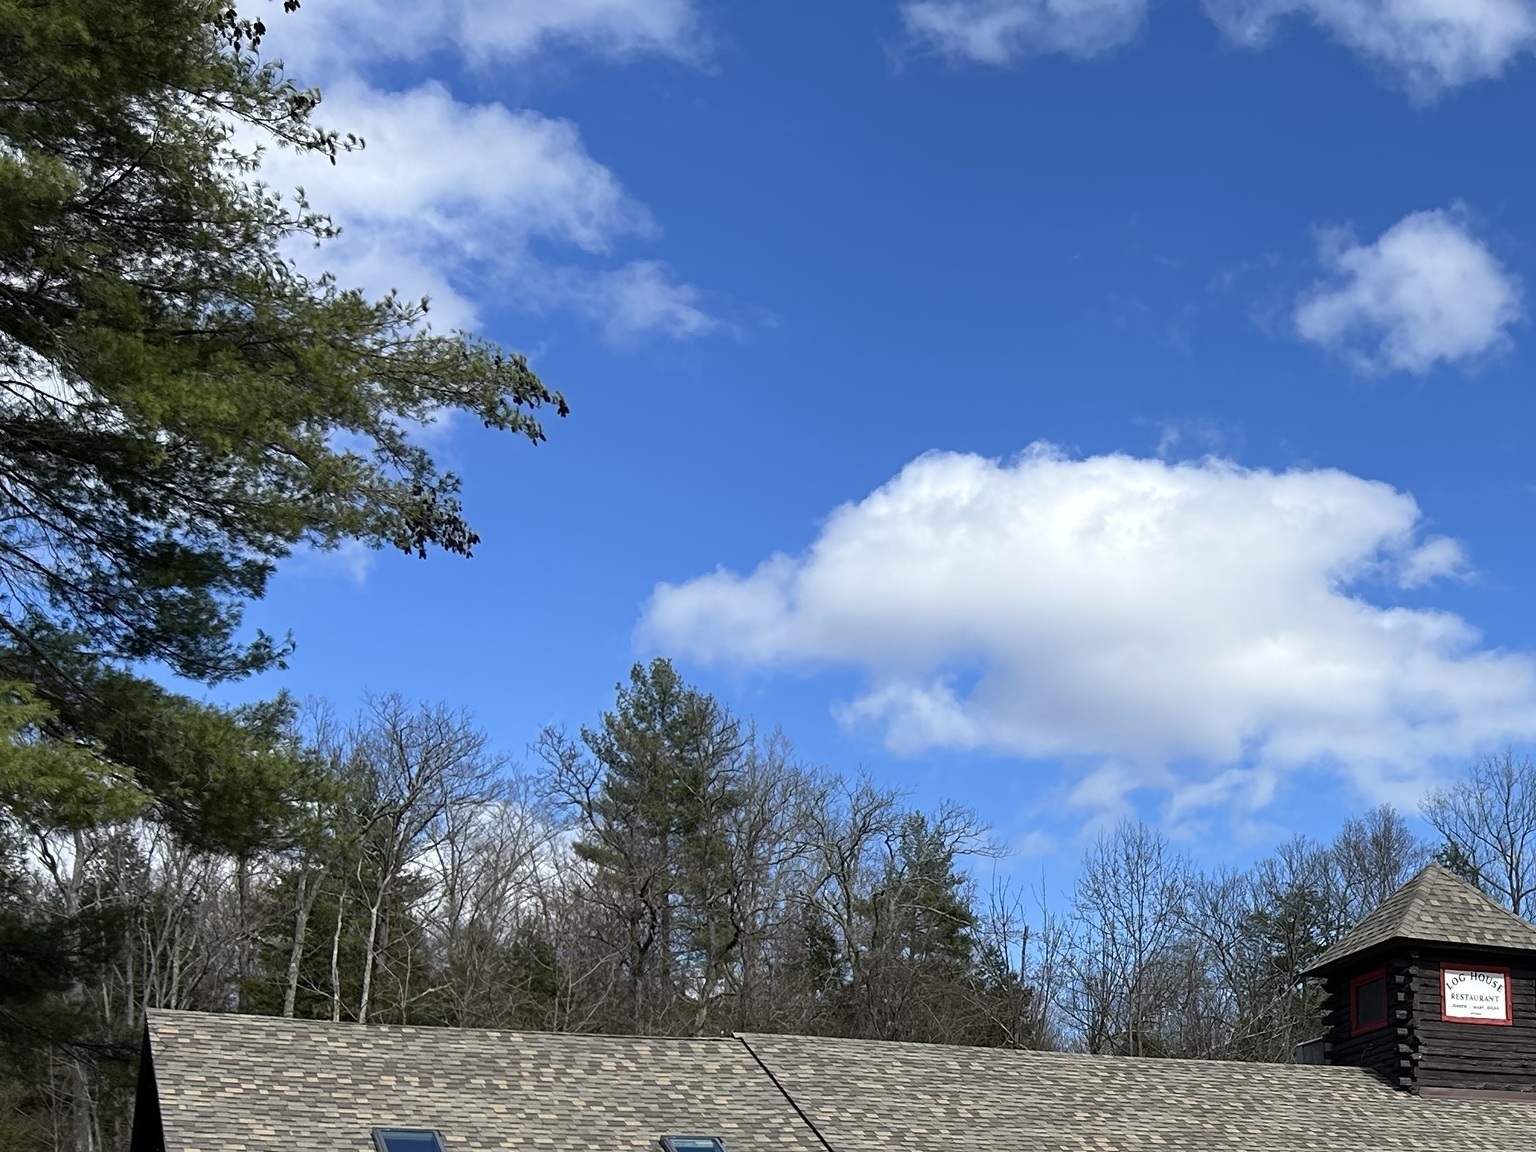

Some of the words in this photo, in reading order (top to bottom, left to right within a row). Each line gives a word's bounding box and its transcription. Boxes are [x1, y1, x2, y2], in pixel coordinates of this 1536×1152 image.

[1446, 973, 1466, 990] LOG
[1470, 971, 1503, 993] HOUSE
[1451, 993, 1499, 1003] RESTAURANT
